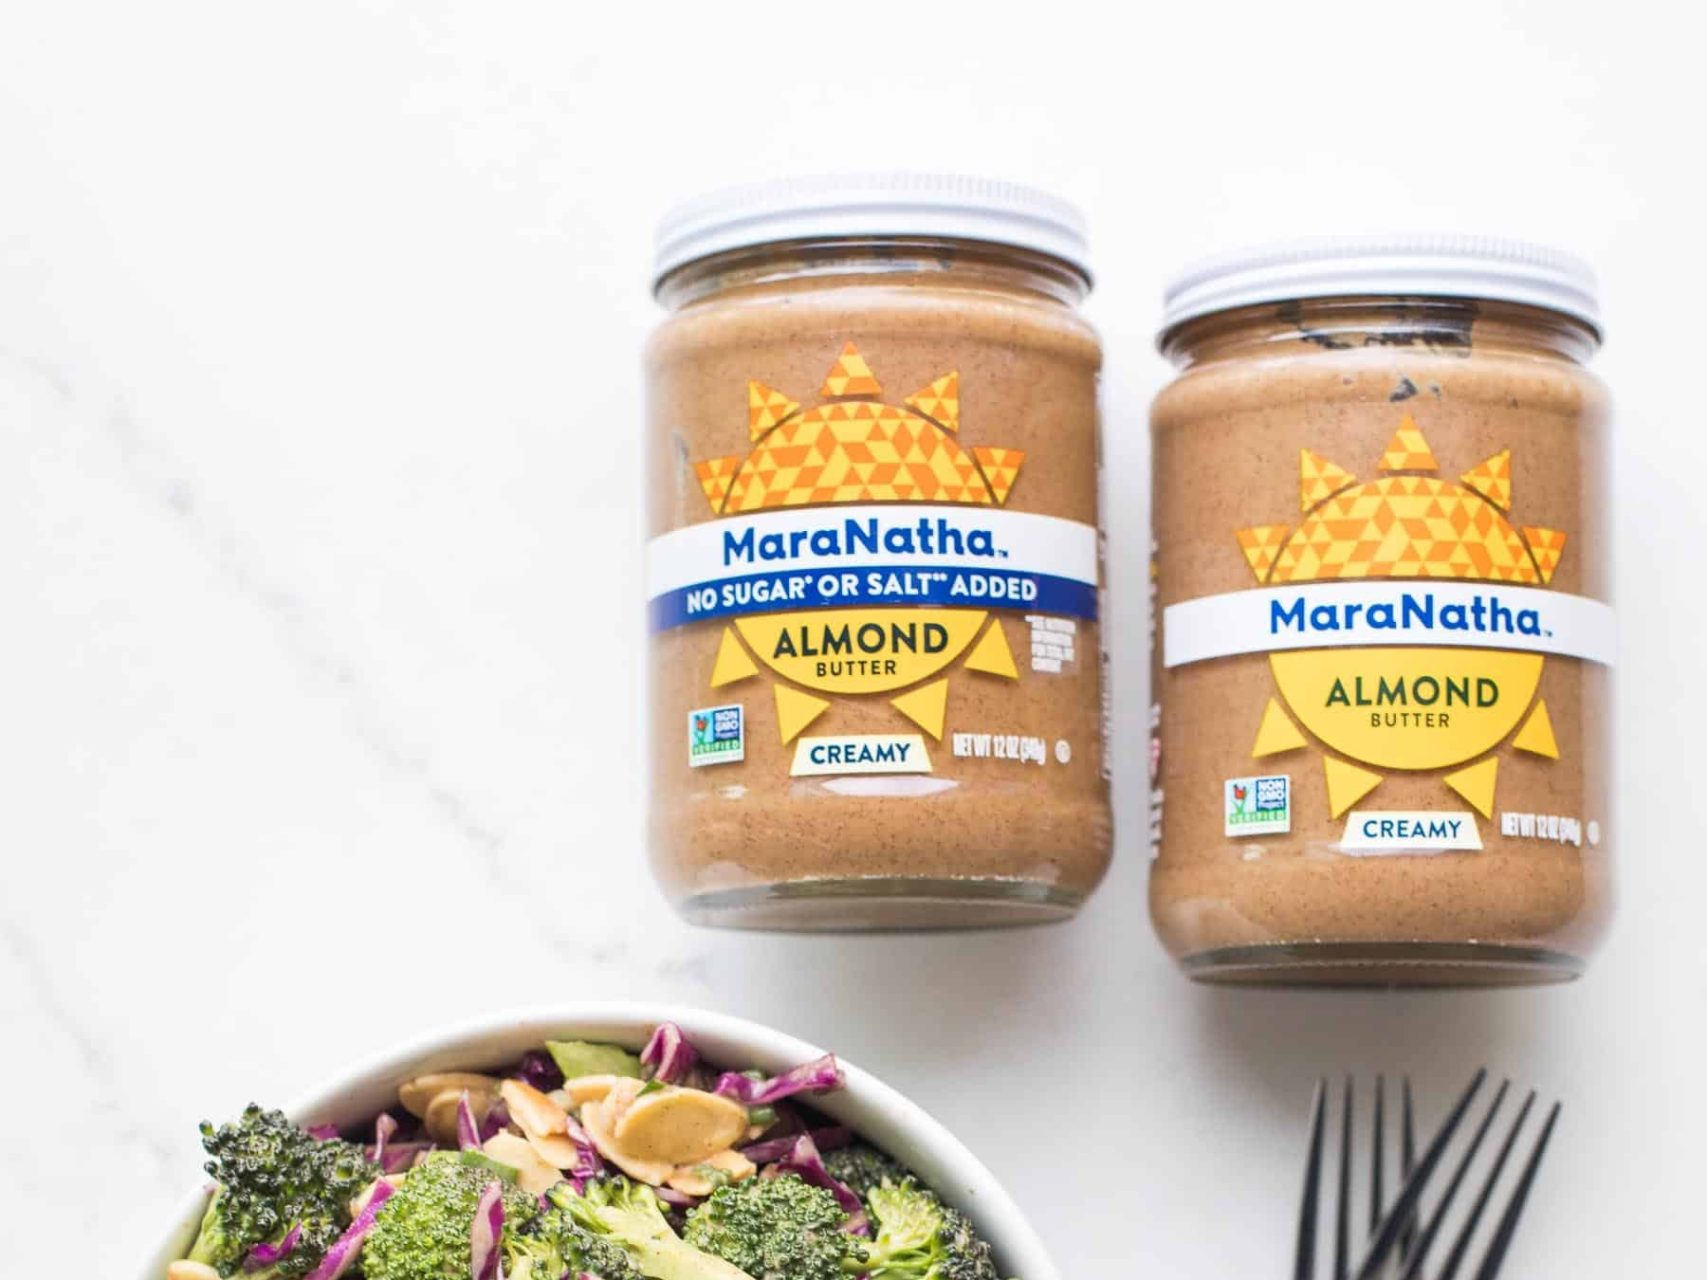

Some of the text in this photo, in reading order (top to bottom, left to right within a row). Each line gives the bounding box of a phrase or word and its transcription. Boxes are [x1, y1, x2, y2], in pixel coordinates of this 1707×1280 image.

[724, 518, 995, 566] MaraNatha
[687, 588, 717, 614] NO
[817, 574, 859, 597] OR
[950, 574, 1038, 601] ADDED
[1270, 594, 1541, 637] MaraNatha
[773, 622, 949, 660] ALMOND
[816, 660, 897, 677] BUTTER
[1324, 675, 1500, 708] ALMOND
[1370, 712, 1450, 728] BUTTER
[810, 742, 911, 765] CREAMY
[1363, 819, 1462, 840] CREAMY
